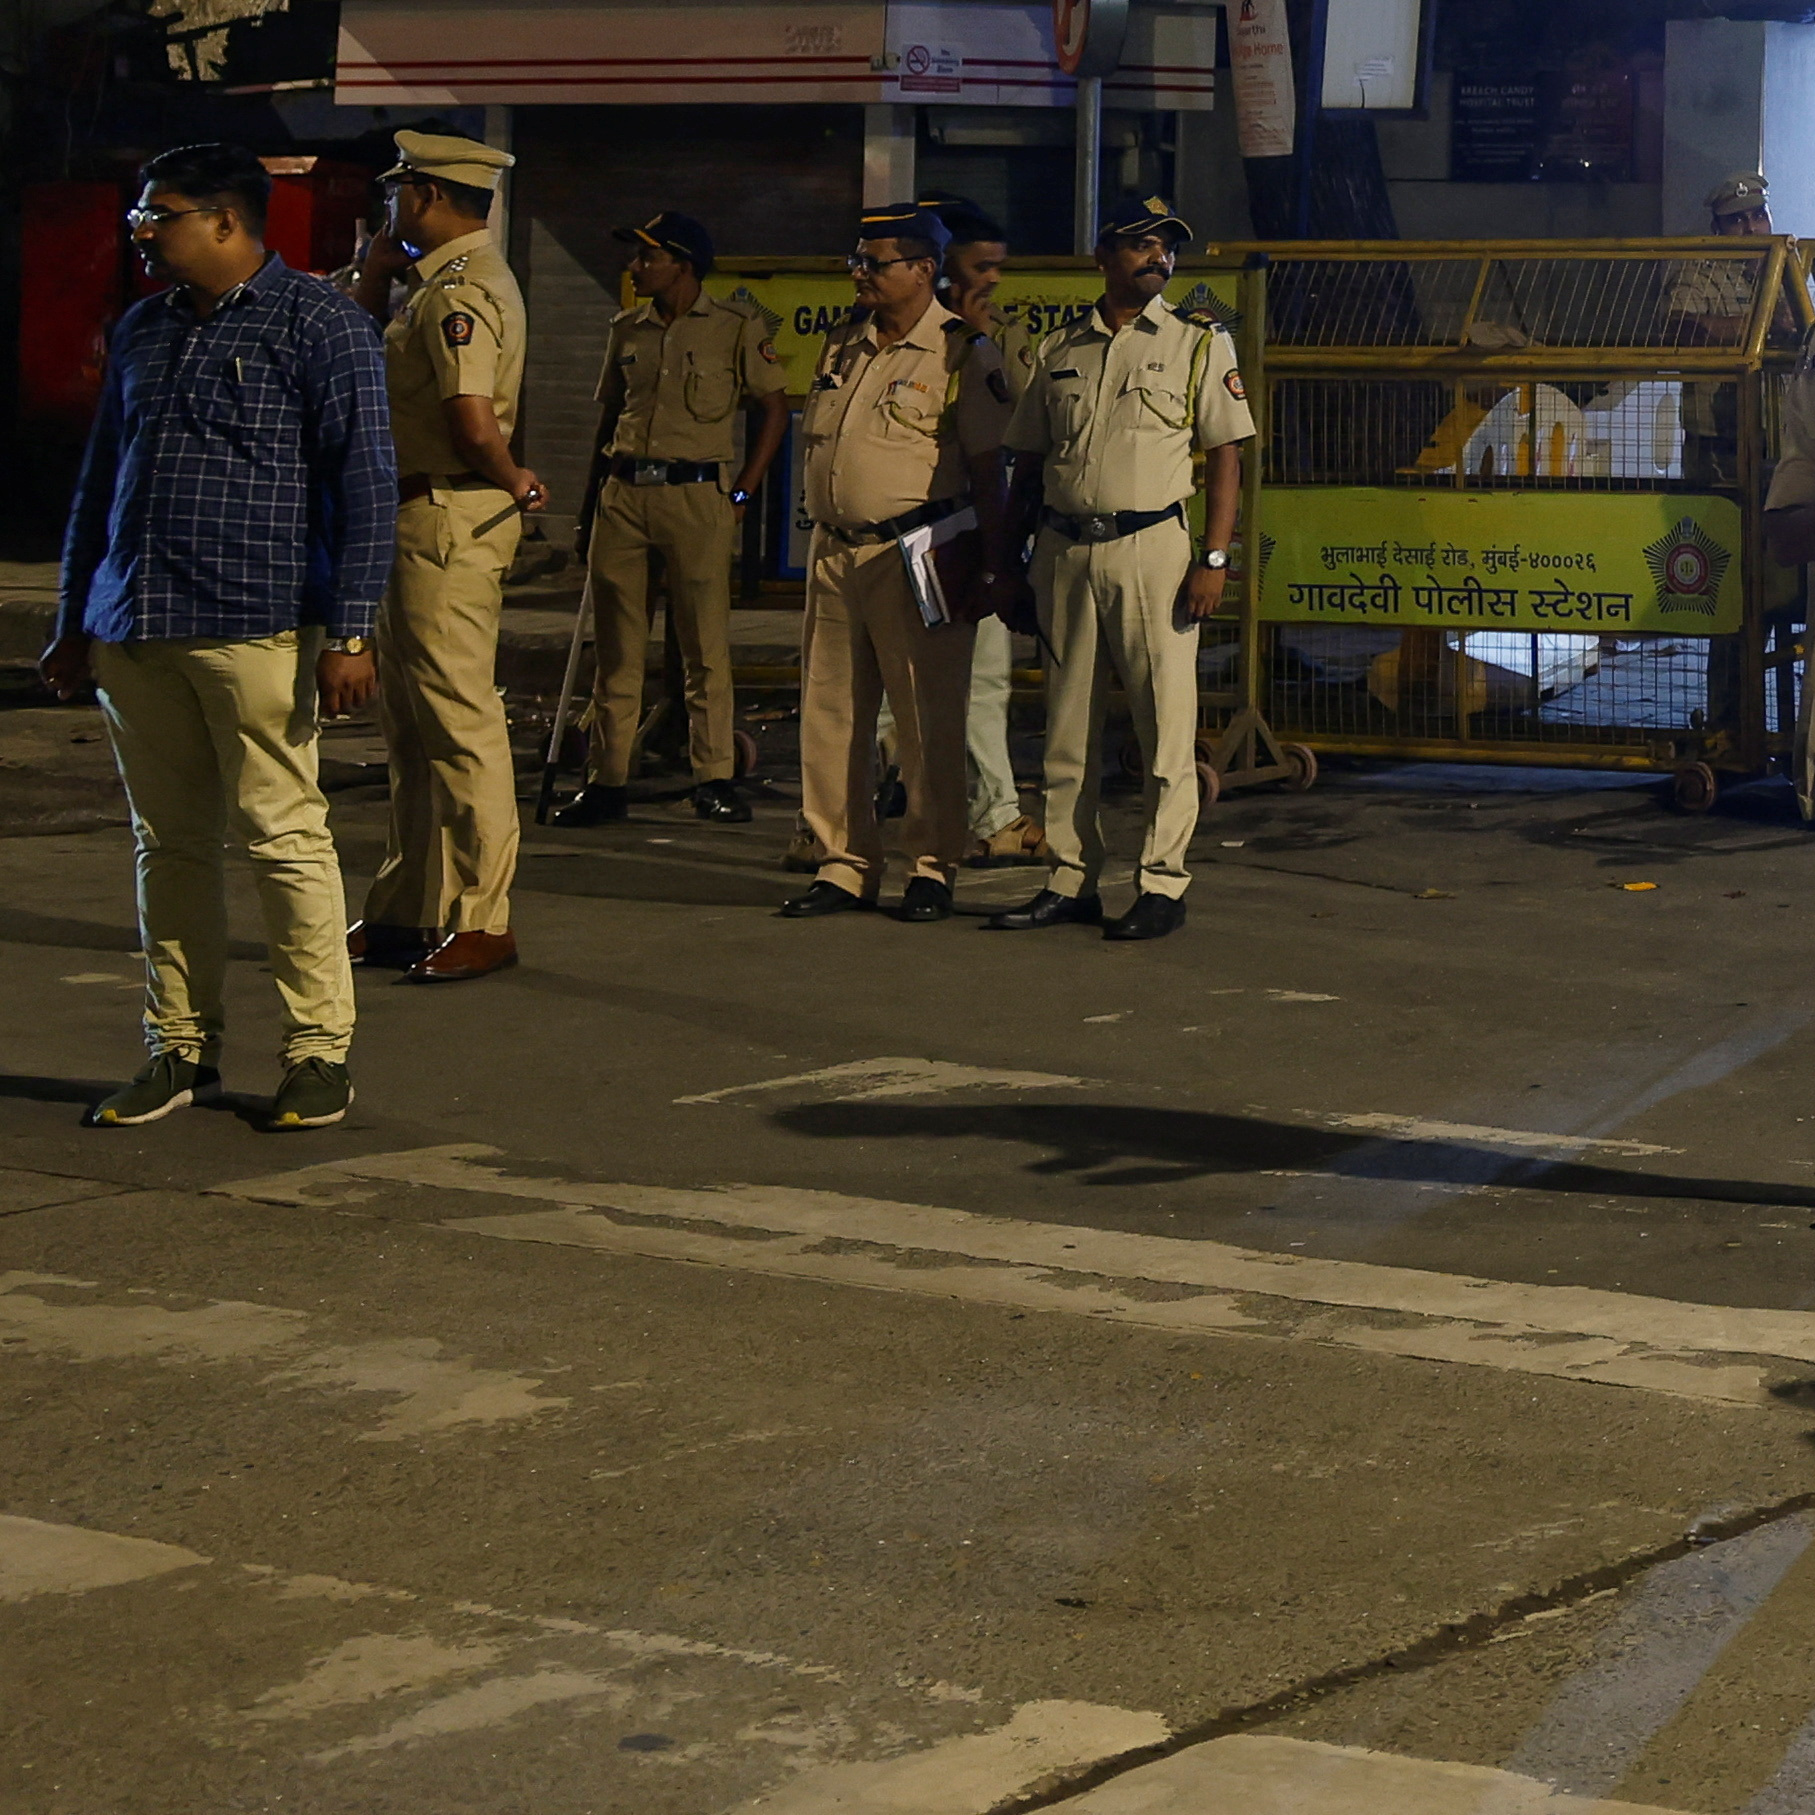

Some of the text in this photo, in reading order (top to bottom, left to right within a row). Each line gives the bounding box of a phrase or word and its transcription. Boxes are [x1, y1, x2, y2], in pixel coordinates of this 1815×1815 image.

[1320, 541, 1388, 571] भुलाभाई
[1393, 541, 1436, 571] देसाई
[1288, 573, 1634, 621] गावदेवी पोलीस स्टेशन
